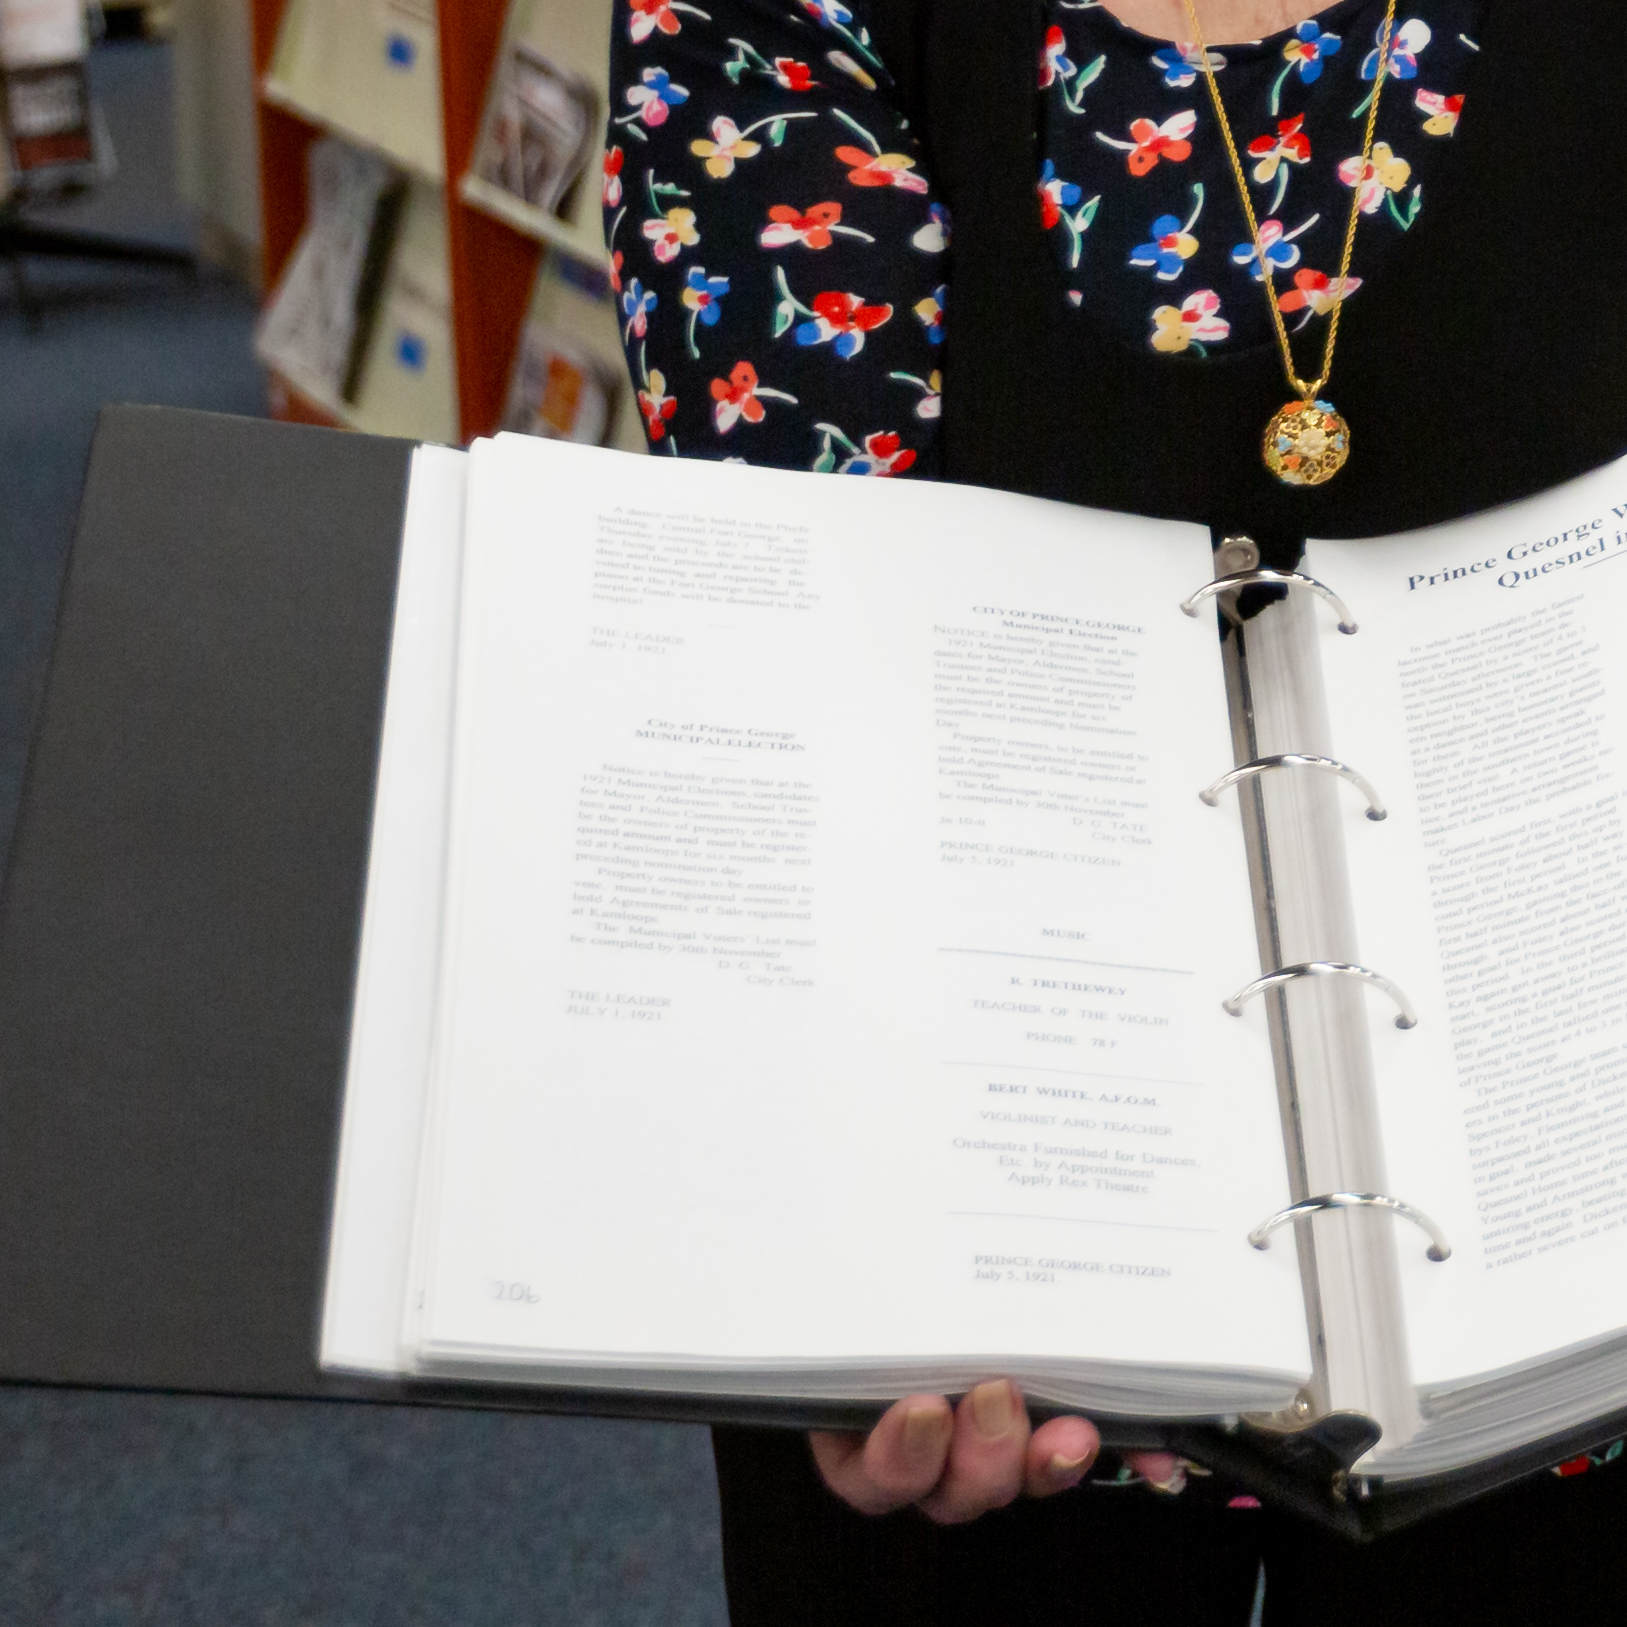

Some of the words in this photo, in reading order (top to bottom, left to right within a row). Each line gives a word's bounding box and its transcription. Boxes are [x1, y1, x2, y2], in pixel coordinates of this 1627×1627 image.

[1406, 554, 1497, 592] Prince
[1506, 518, 1604, 562] George
[1496, 540, 1607, 589] Quesnel
[972, 605, 1007, 616] CITY
[1010, 610, 1030, 619] OF
[1031, 612, 1085, 627] PRINCE
[1085, 619, 1146, 634] GEORGE
[1001, 620, 1064, 634] Municipal
[1068, 627, 1118, 641] Election
[588, 638, 616, 649] July
[637, 644, 667, 654] 1921
[590, 625, 621, 637] THE
[624, 630, 685, 645] LEADER
[646, 717, 676, 732] City
[681, 722, 695, 730] of
[699, 723, 744, 735] Prince
[747, 728, 797, 740] George
[635, 729, 727, 746] MUNICIPAL
[727, 739, 806, 752] ELECTION
[940, 840, 995, 853] PRINCE
[998, 845, 1060, 859] GEORGE
[1062, 852, 1122, 867] CITIZEN
[940, 853, 966, 863] July
[970, 855, 982, 865] 5,
[987, 857, 1015, 867] 1921
[1041, 928, 1092, 941] MUSIC
[1031, 978, 1128, 996] TRETHEWEY
[971, 999, 1042, 1014] TEACHER
[1051, 1006, 1071, 1016] OF
[1079, 1009, 1109, 1021] THE
[1117, 1013, 1170, 1026] VIOLIN
[1026, 1031, 1078, 1045] PHONE
[1091, 1038, 1107, 1047] 78
[988, 1083, 1030, 1094] BERT
[1036, 1086, 1094, 1101] WHITE,
[979, 1111, 1058, 1125] VIOLINIST
[1062, 1118, 1097, 1129] AND
[1101, 1121, 1173, 1136] TEACHER
[952, 1137, 1028, 1153] Orchestra
[1034, 1142, 1108, 1160] Furnished
[1114, 1150, 1136, 1162] for
[1141, 1152, 1202, 1169] Dances,
[999, 1156, 1028, 1168] Etc.
[1033, 1158, 1052, 1171] by
[1058, 1161, 1159, 1179] Appointment.
[1008, 1171, 1054, 1186] Apply
[1059, 1176, 1089, 1188] Rex
[1093, 1178, 1151, 1193] Theatre
[972, 1268, 1002, 1281] July
[1006, 1271, 1020, 1281] 5,
[974, 1254, 1034, 1266] PRINCE
[1038, 1258, 1105, 1273] GEORGE
[1109, 1263, 1172, 1277] CITIZEN
[494, 1280, 541, 1304] 206
